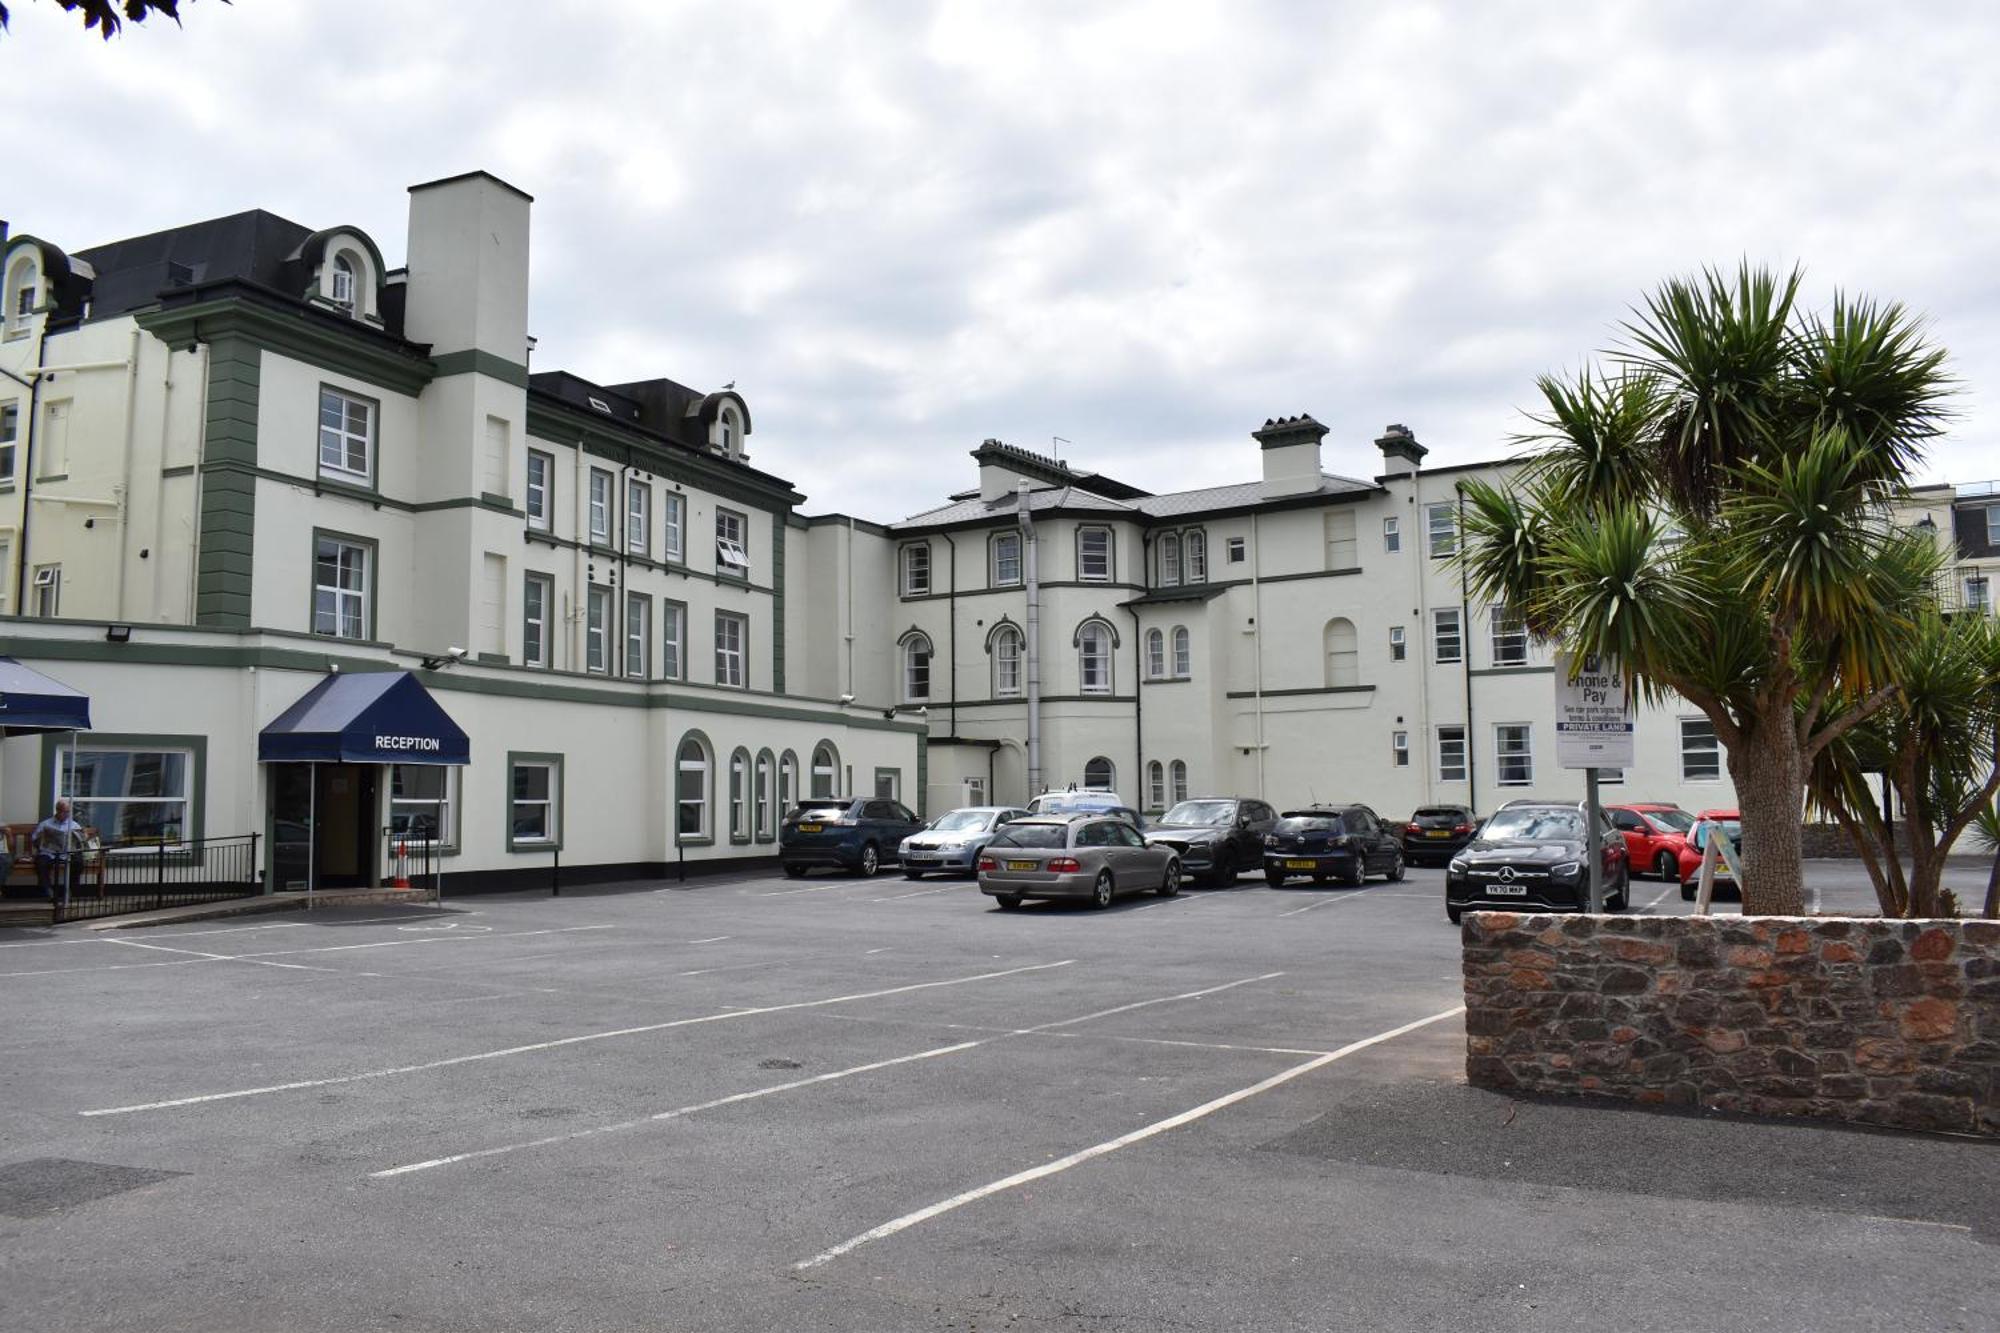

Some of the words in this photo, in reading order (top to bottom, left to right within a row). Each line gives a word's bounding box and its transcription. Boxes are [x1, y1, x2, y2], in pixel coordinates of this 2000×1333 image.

[1612, 674, 1622, 688] &
[1583, 688, 1607, 705] Pay
[1563, 723, 1600, 731] PRIVATE
[375, 735, 440, 751] RECEPTION
